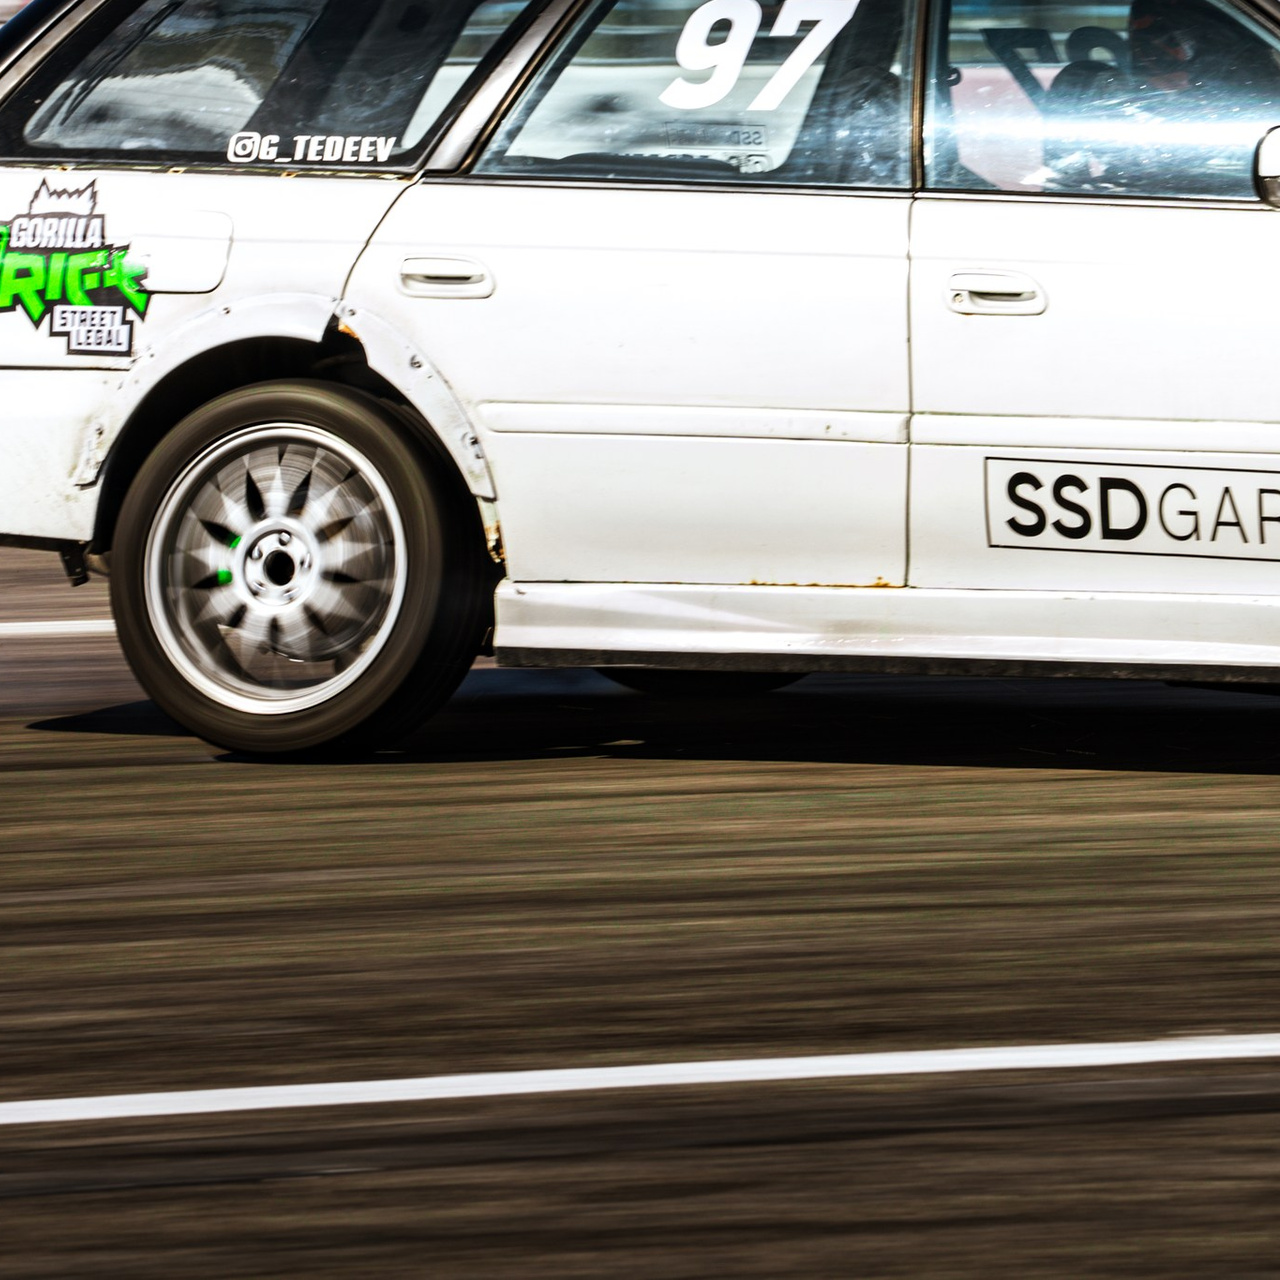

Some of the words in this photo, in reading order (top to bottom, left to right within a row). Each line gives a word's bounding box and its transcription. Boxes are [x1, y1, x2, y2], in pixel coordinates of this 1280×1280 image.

[9, 217, 103, 249] GORILLA
[60, 310, 117, 327] STREET
[77, 329, 123, 347] LEGAL
